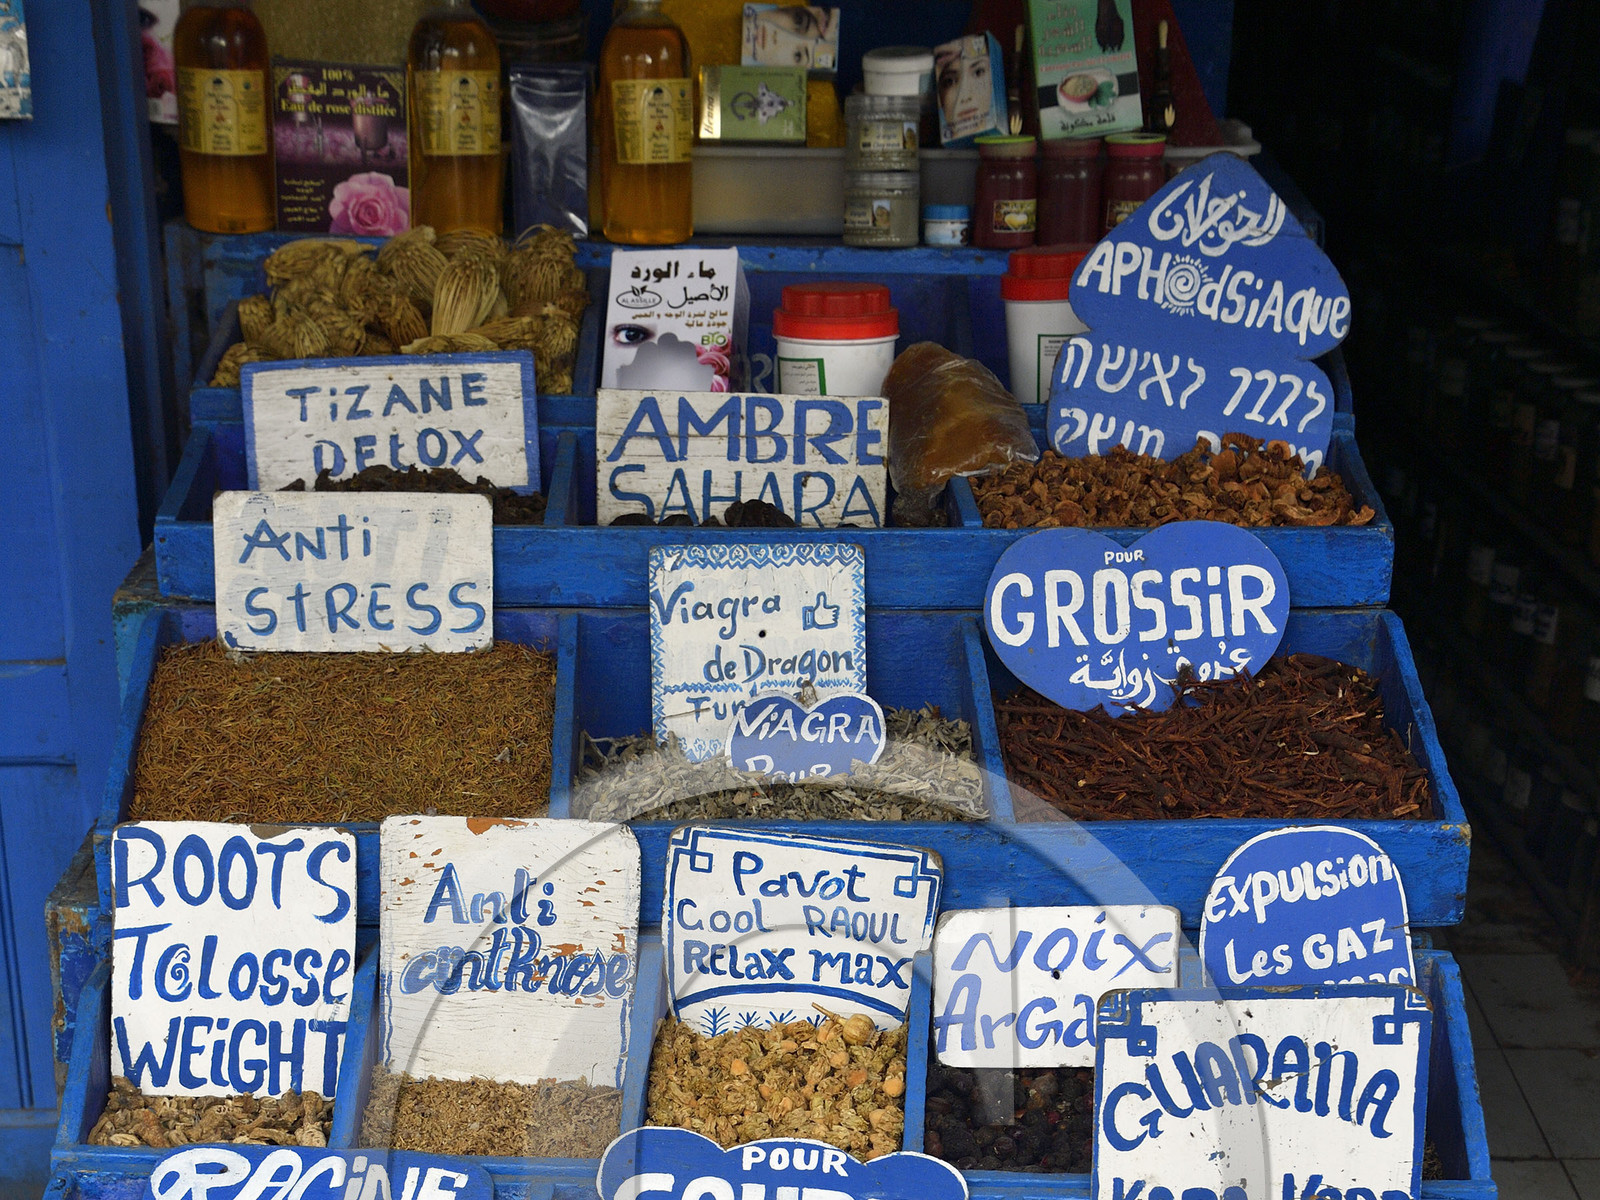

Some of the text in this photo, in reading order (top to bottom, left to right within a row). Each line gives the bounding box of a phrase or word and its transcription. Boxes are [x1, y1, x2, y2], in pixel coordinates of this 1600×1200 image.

[281, 98, 305, 112] Eau
[308, 100, 323, 113] de
[326, 103, 351, 114] rose
[630, 260, 716, 283] ماء الورد
[666, 283, 729, 309] الأصيل
[605, 395, 884, 466] AMBRE
[608, 463, 882, 529] SAHARA
[1103, 549, 1146, 565] POUR
[650, 580, 782, 640] Viagra
[702, 643, 857, 690] de Dragon
[113, 826, 351, 924] ROOTS
[423, 862, 558, 927] Anti
[732, 850, 871, 903] Pavot
[802, 904, 908, 945] RAOUL
[1224, 917, 1394, 986] Les GAZ
[741, 1145, 850, 1178] POUR
